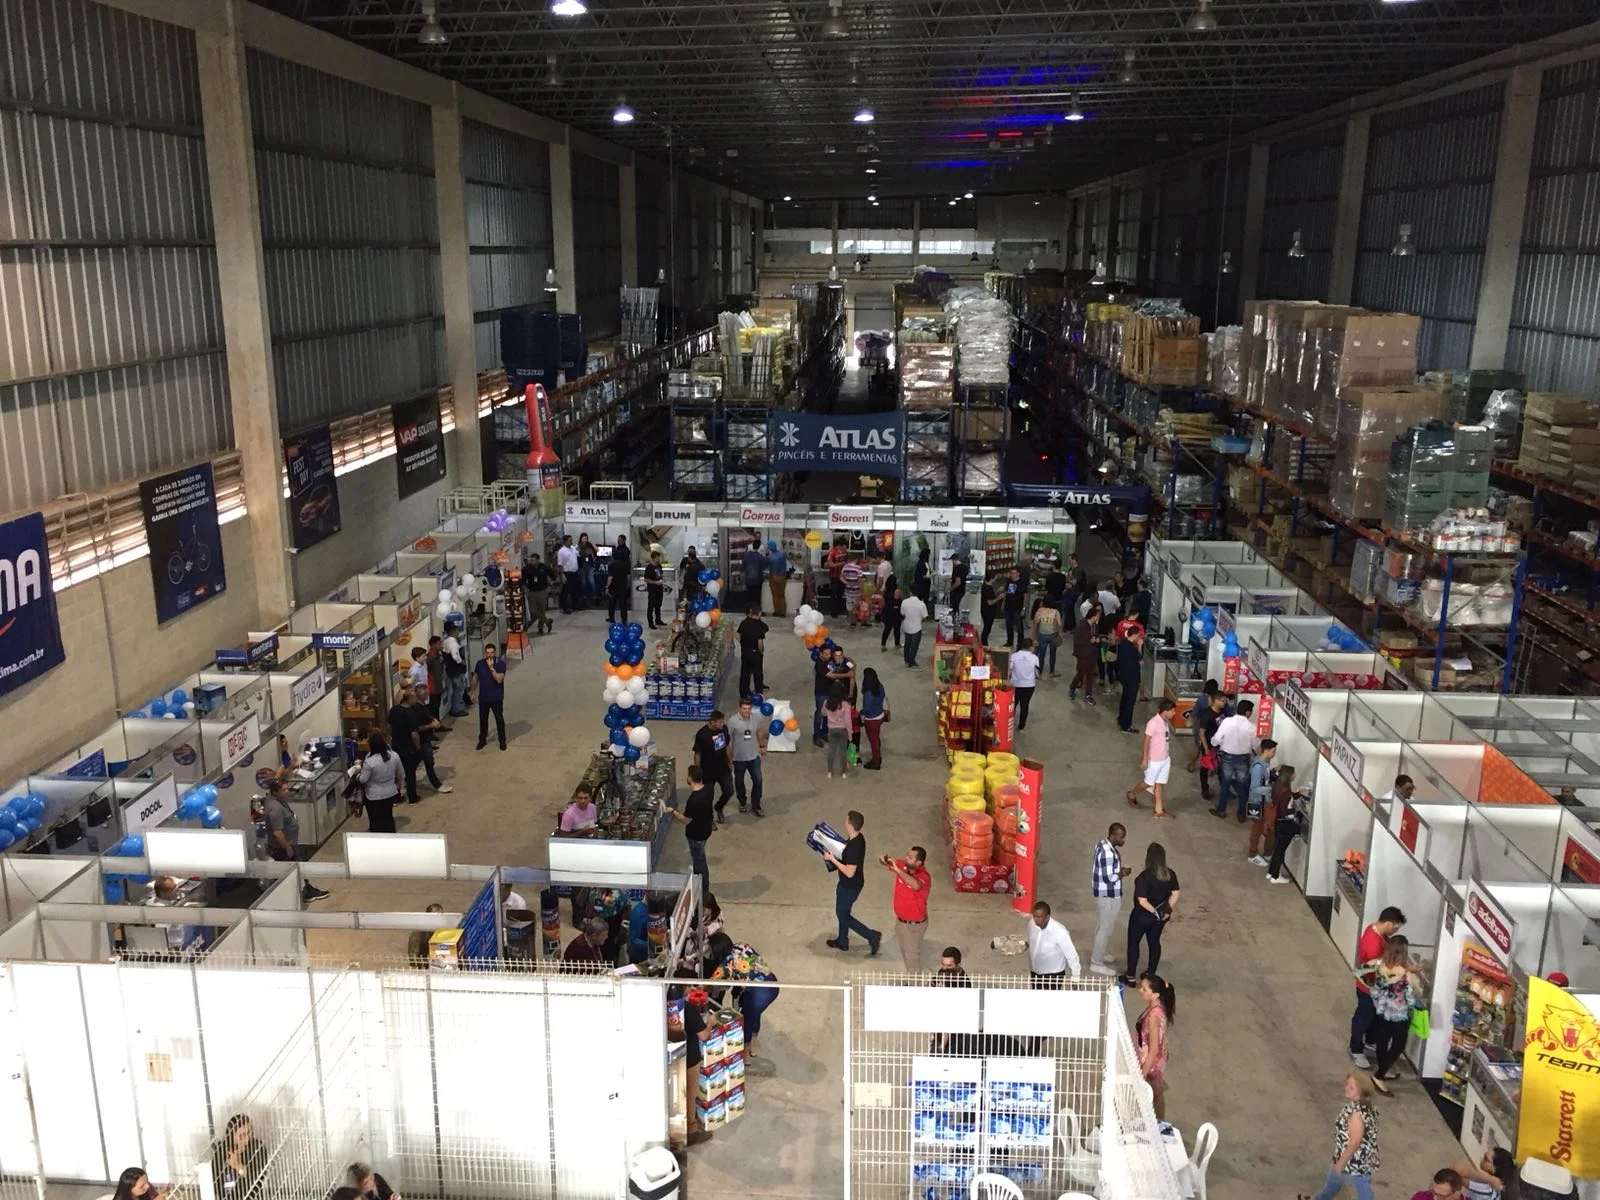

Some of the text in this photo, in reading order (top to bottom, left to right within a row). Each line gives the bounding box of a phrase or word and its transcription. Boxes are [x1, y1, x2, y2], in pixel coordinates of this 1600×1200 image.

[818, 426, 896, 449] ATLAS
[778, 450, 815, 460] PINCÉIS
[832, 451, 897, 464] FERRAMENTAS
[1064, 491, 1111, 504] ATLAS
[580, 507, 606, 516] ATLAS
[654, 511, 691, 519] BRUM
[742, 509, 780, 520] CORTAG
[831, 513, 869, 523] Starrett
[351, 633, 375, 659] montana
[293, 680, 317, 707] hydra
[140, 800, 163, 822] DOCOL
[1477, 906, 1509, 948] adelbras
[1536, 1053, 1600, 1075] Team
[1549, 1090, 1576, 1163] Starrett
